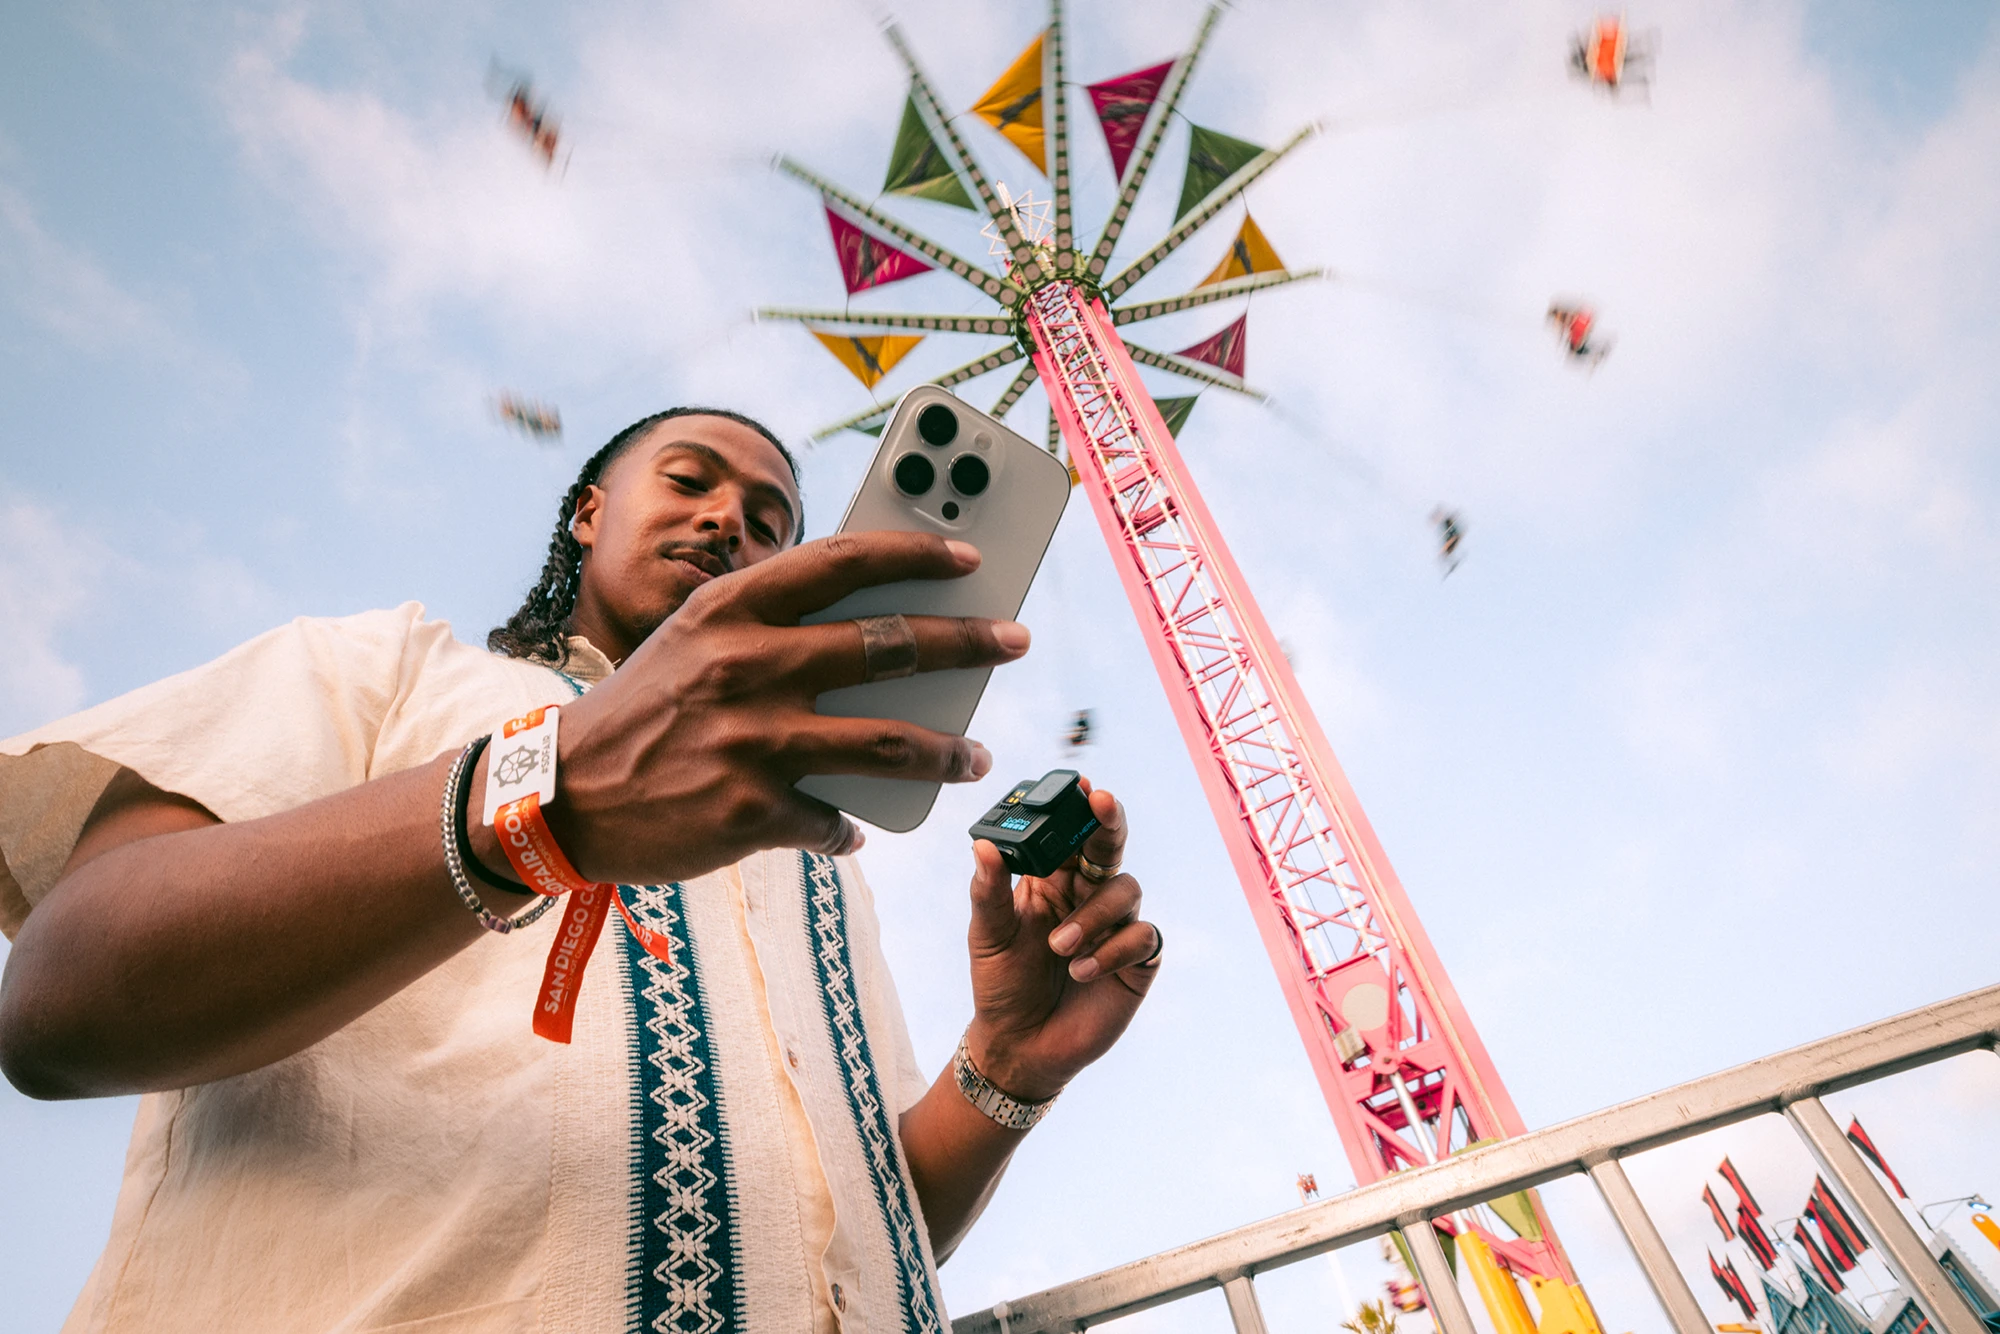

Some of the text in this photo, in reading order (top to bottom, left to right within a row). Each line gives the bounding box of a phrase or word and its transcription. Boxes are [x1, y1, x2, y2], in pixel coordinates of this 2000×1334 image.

[541, 733, 552, 774] #SDFAIR
[1006, 817, 1030, 826] GoPro
[1070, 818, 1096, 845] LIT HERO
[544, 970, 566, 1014] SAN
[555, 908, 588, 970] DIEGO
